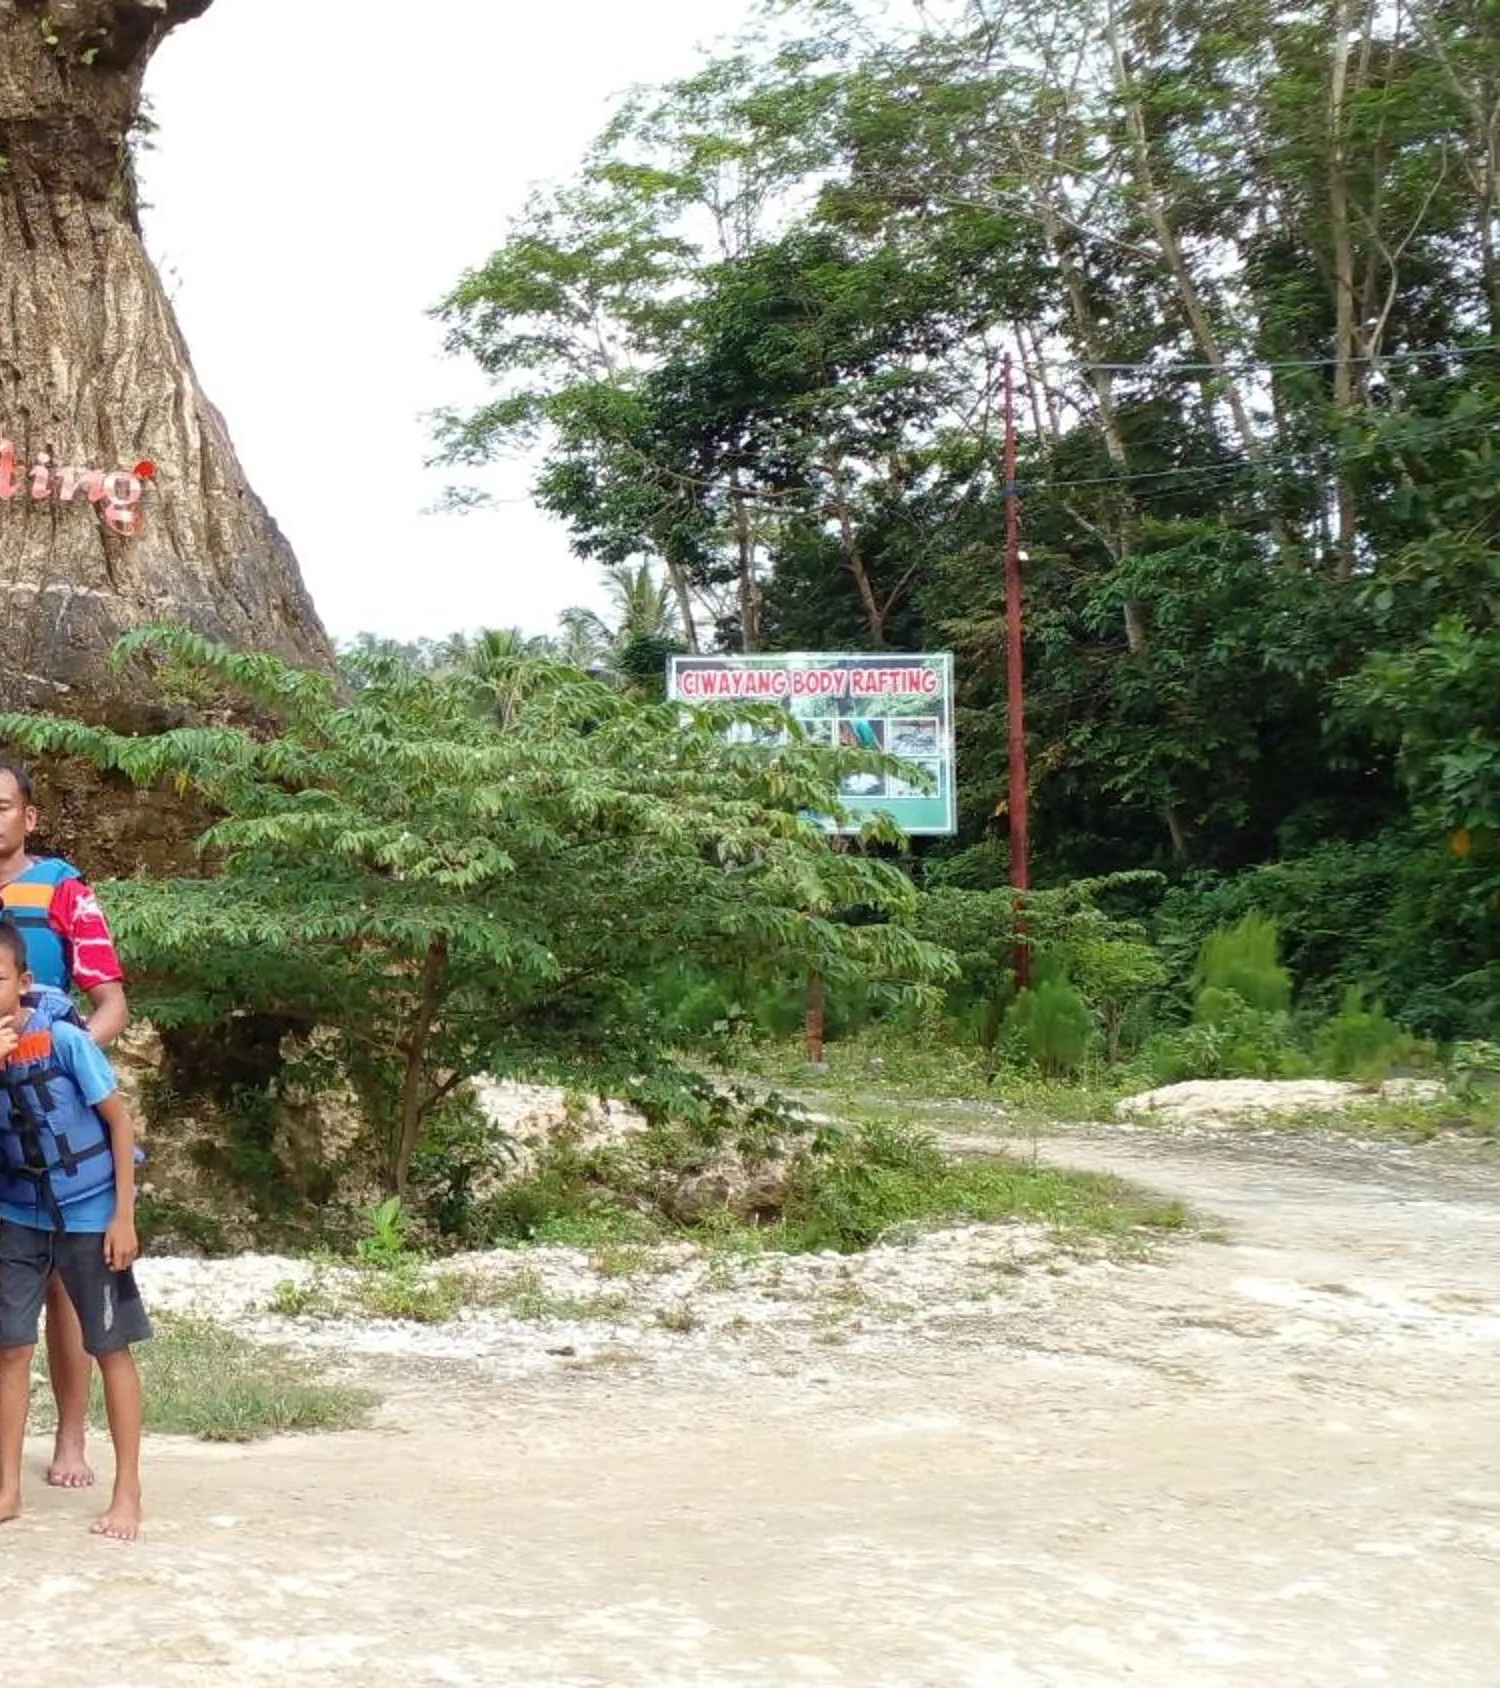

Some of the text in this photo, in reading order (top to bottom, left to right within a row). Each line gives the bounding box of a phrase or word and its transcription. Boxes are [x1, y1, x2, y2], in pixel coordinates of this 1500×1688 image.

[681, 668, 938, 696] CIWAYANG BODY RAFTING
